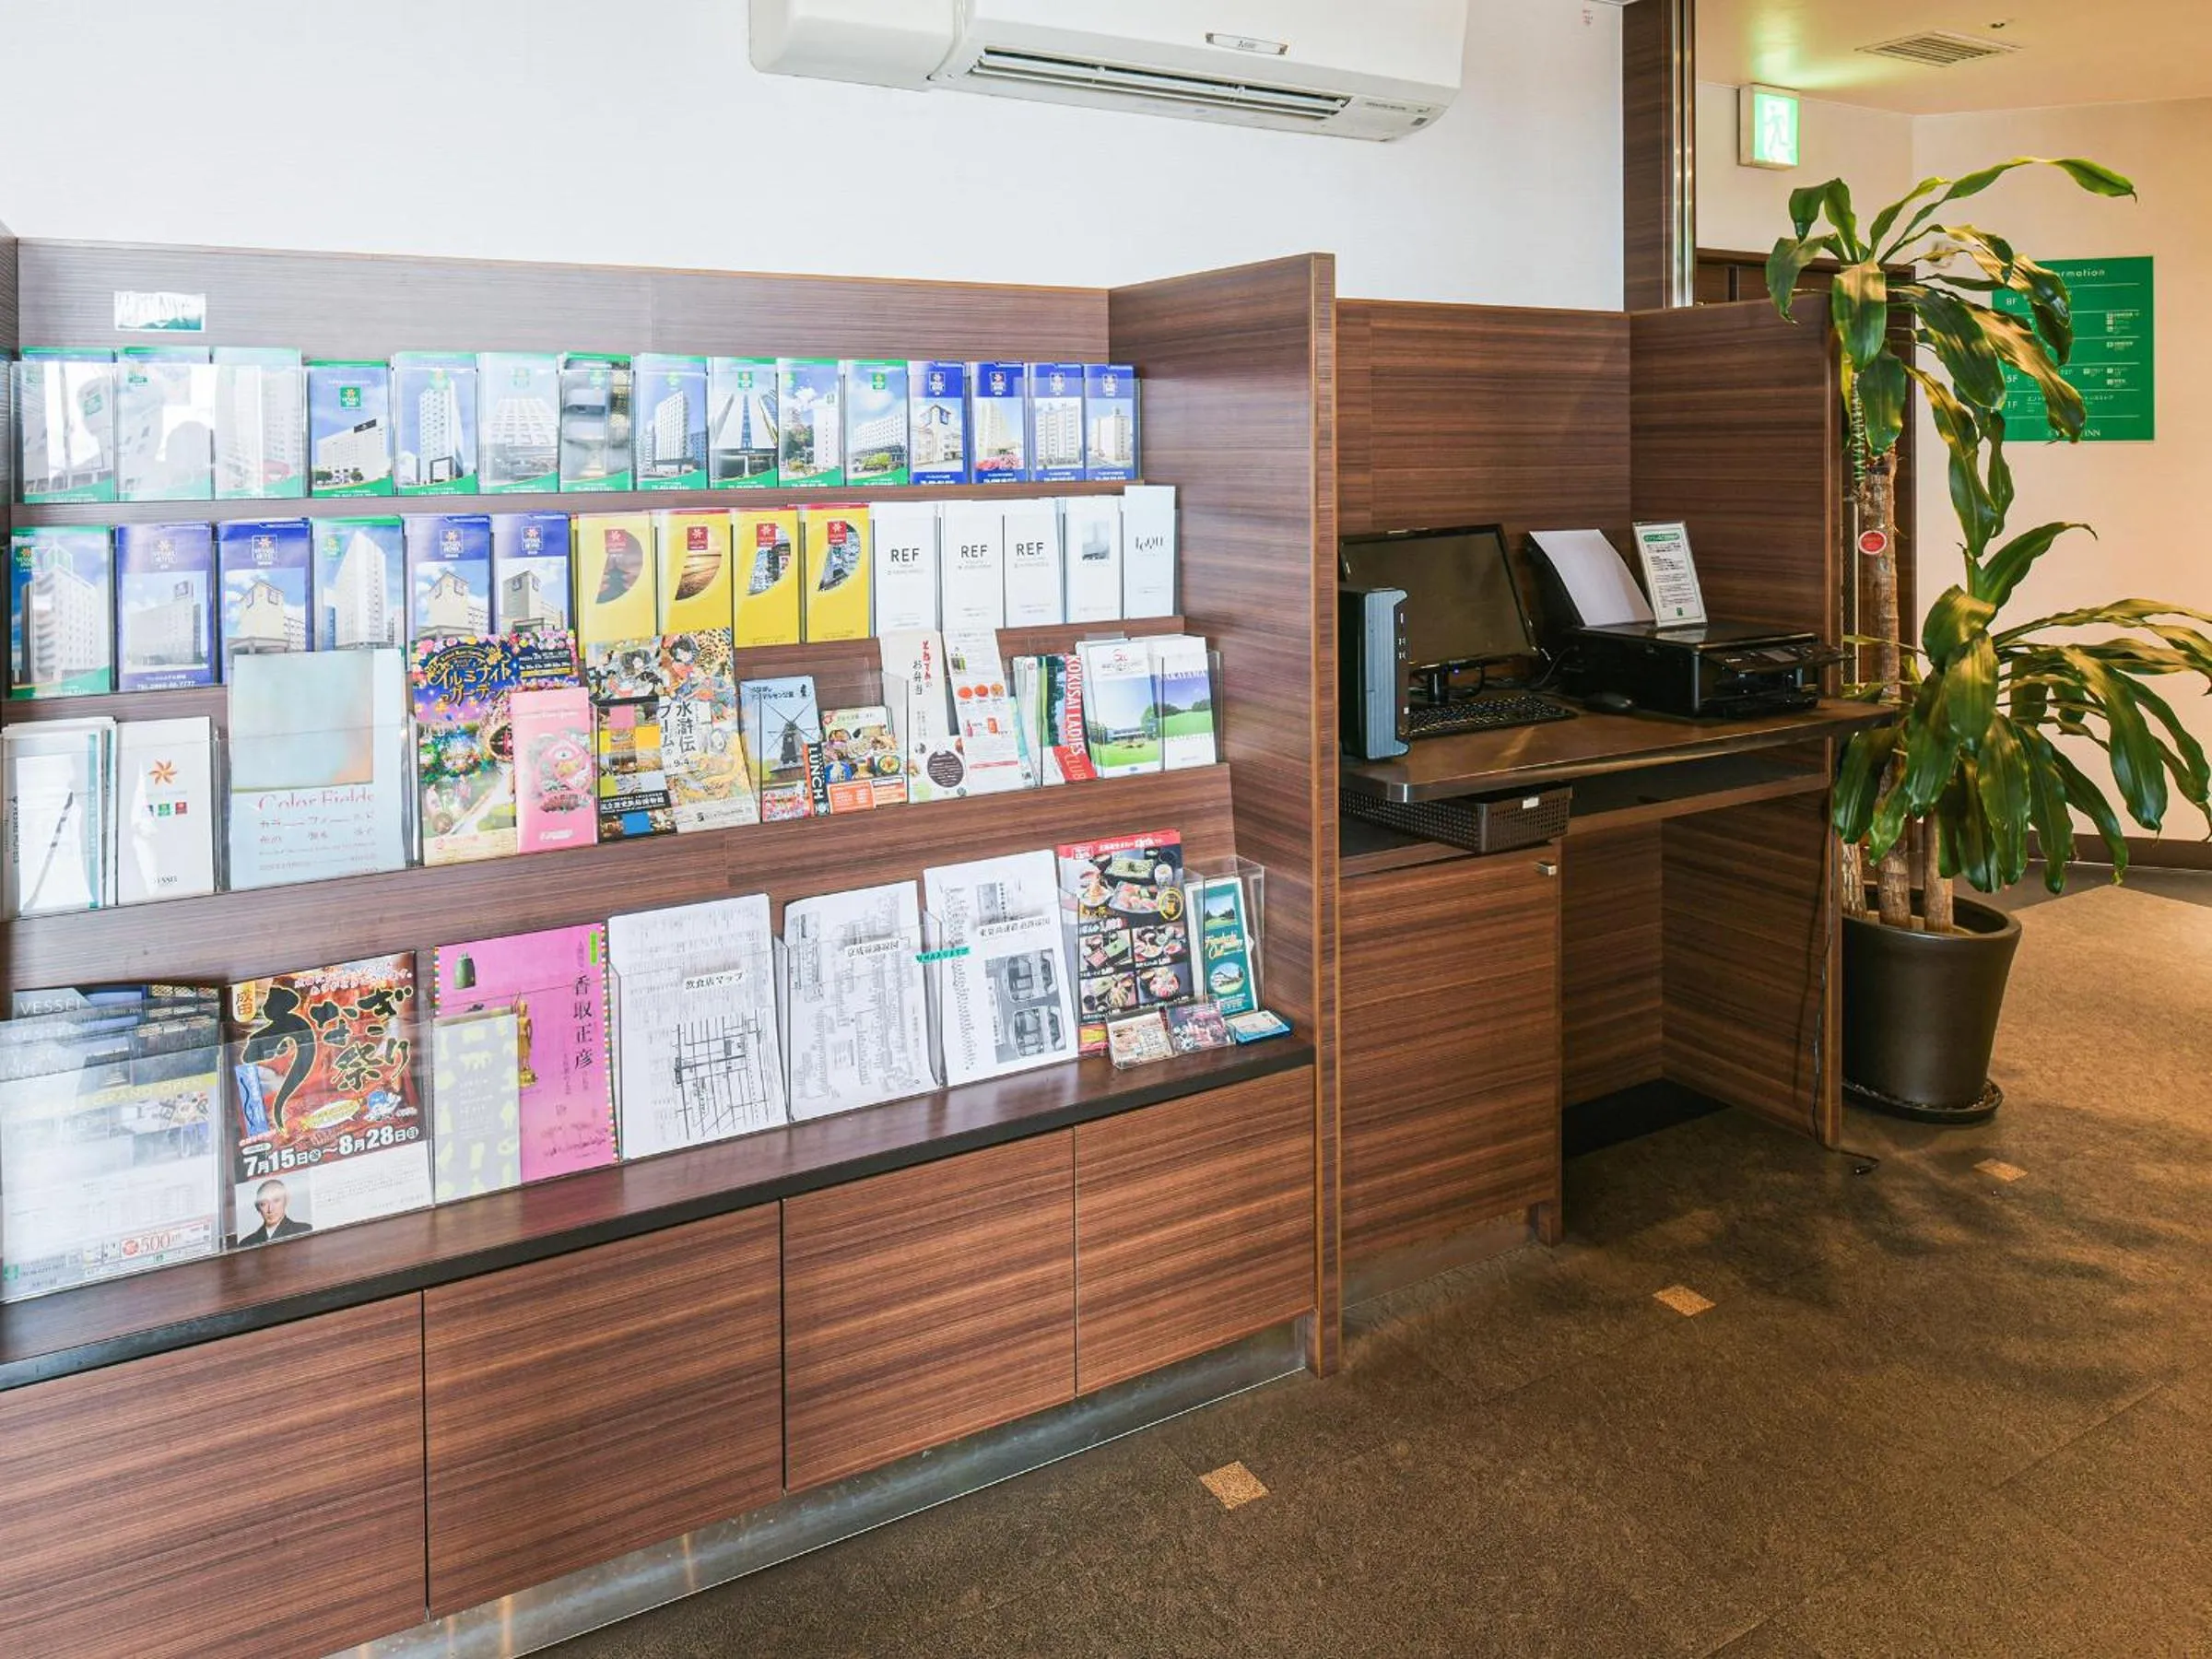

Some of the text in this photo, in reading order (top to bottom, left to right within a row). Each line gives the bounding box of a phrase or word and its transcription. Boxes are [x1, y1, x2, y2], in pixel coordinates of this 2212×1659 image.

[890, 548, 920, 562] REF
[960, 544, 988, 559] REF
[1016, 541, 1044, 556] REF
[1065, 654, 1082, 709] KOKUSAI
[676, 700, 697, 754] 水滸伝
[808, 747, 824, 800] LUNCH
[685, 971, 743, 990] 飲食店マップ
[236, 990, 253, 1017] 成田
[573, 974, 594, 1070] 香取正彦
